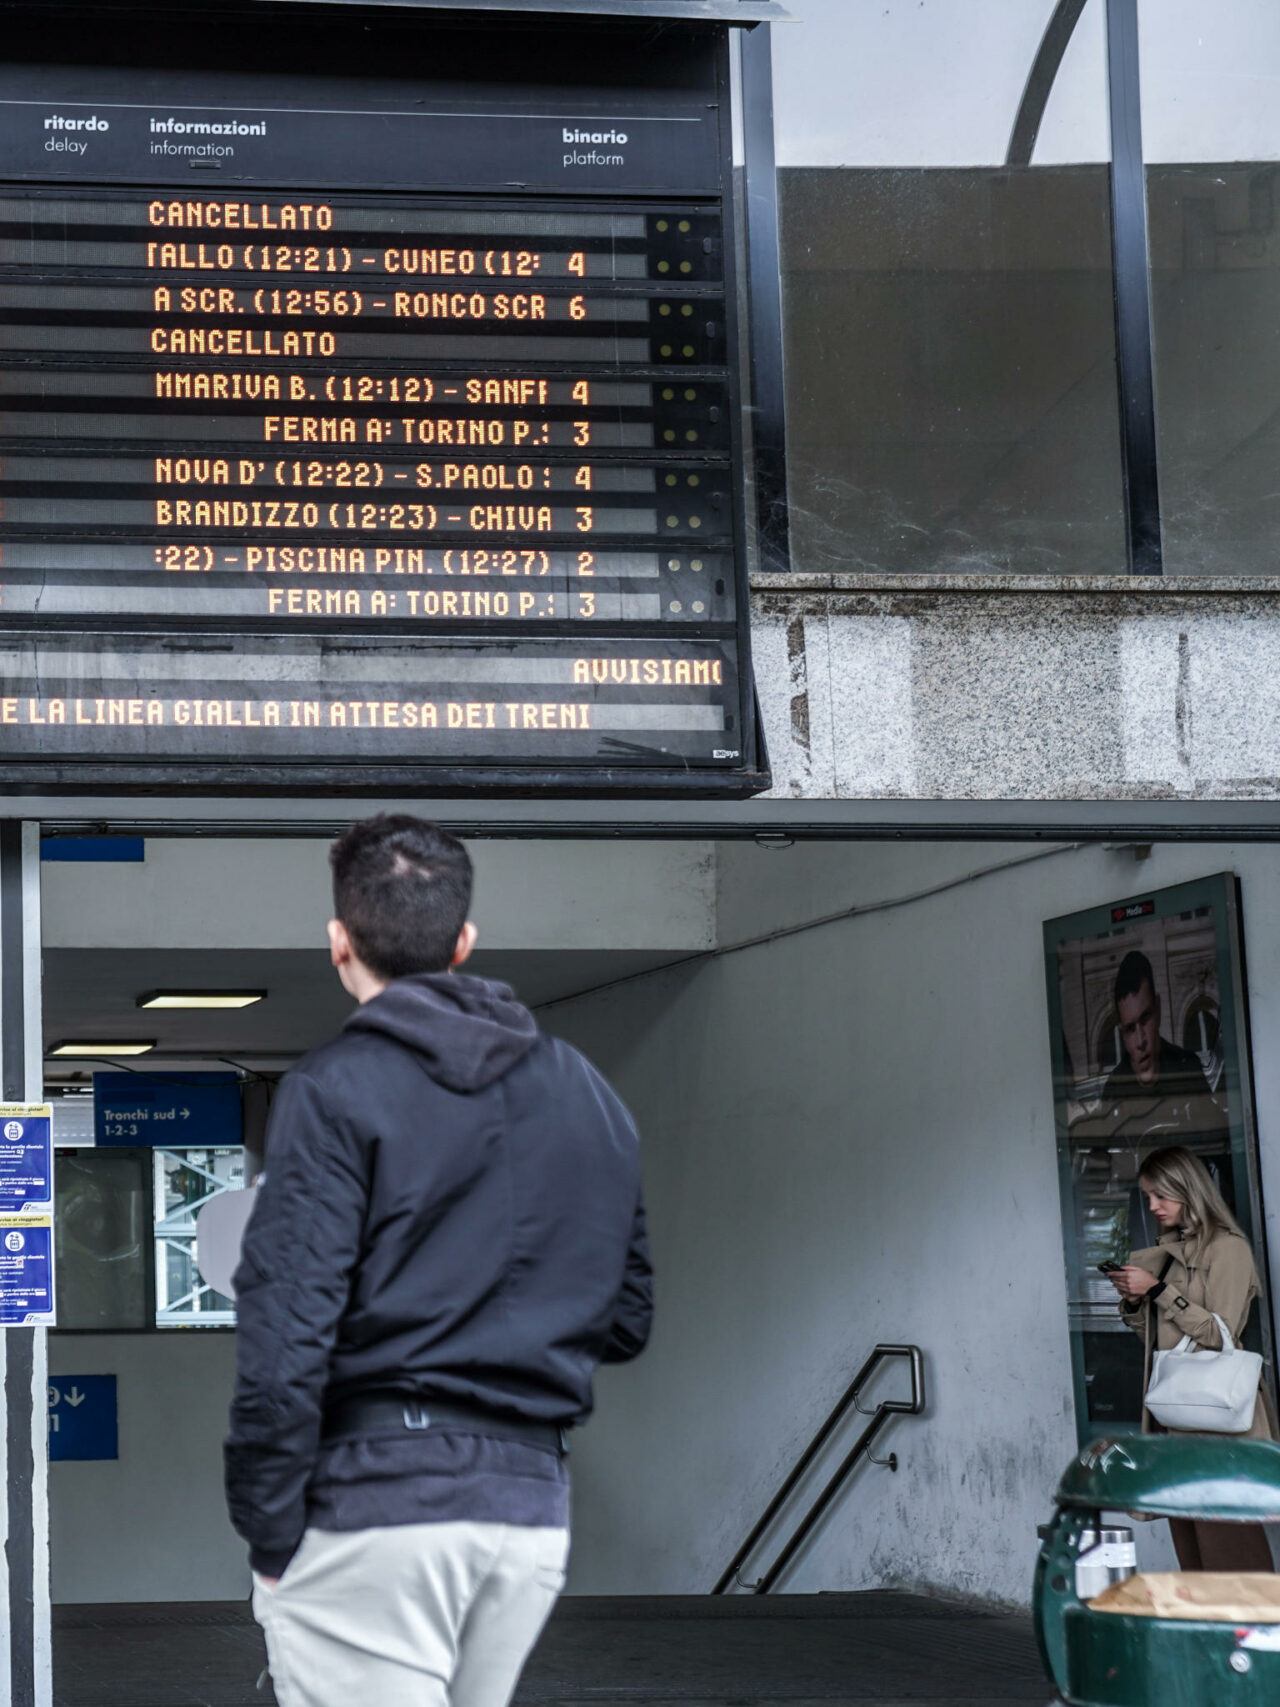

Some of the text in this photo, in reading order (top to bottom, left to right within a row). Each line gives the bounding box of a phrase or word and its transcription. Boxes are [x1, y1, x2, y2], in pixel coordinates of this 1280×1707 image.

[45, 115, 109, 131] ritardo
[151, 118, 266, 135] informazioni
[45, 137, 87, 155] delay
[151, 140, 233, 156] information
[563, 128, 627, 144] binario
[564, 150, 623, 167] platform
[149, 200, 332, 231] CANCELLATO
[244, 245, 352, 272] (12:21)
[384, 248, 475, 274] CUNEO
[484, 250, 540, 276] (12:
[567, 252, 585, 277] 4
[154, 286, 170, 312] A
[181, 287, 244, 313] SCR.
[254, 289, 362, 316] (12:56)
[395, 292, 486, 319] RONCO
[493, 294, 545, 319] SCR
[569, 295, 586, 320] 6
[151, 328, 335, 356] CANCELLATO
[156, 372, 280, 400] MMARIVA
[290, 375, 316, 400] B.
[325, 376, 434, 402] (12:12)
[572, 381, 589, 405] 4
[264, 416, 356, 442] FERMA
[366, 418, 391, 443] A:
[402, 418, 504, 445] TORINO
[573, 421, 590, 446] 3
[156, 458, 229, 484] NOVA
[239, 460, 265, 485] D'
[275, 461, 384, 487] (12:22)
[415, 463, 533, 489] S.PAOLO
[575, 466, 591, 490] 4
[156, 499, 319, 528] BRANDIZZO
[329, 503, 437, 530] (12:23)
[470, 505, 552, 531] CHIVA
[576, 507, 593, 532] 3
[155, 545, 214, 571] :22)
[246, 546, 366, 573] PISCINA
[375, 548, 433, 574] PIN.
[443, 549, 550, 576] (12:27)
[577, 551, 595, 577] 2
[268, 588, 361, 615] FERMA
[370, 590, 396, 615] A:
[406, 590, 510, 617] TORINO
[579, 592, 596, 618] 3
[29, 698, 66, 724] LA
[75, 698, 164, 725] LINEA
[173, 699, 281, 726] GIALLA
[290, 701, 320, 727] IN
[329, 701, 438, 728] ATTESA
[447, 702, 496, 729] DEI
[506, 703, 590, 729] TRENI
[103, 1108, 176, 1121] Tronchi sud
[104, 1124, 138, 1136] 1-2-3
